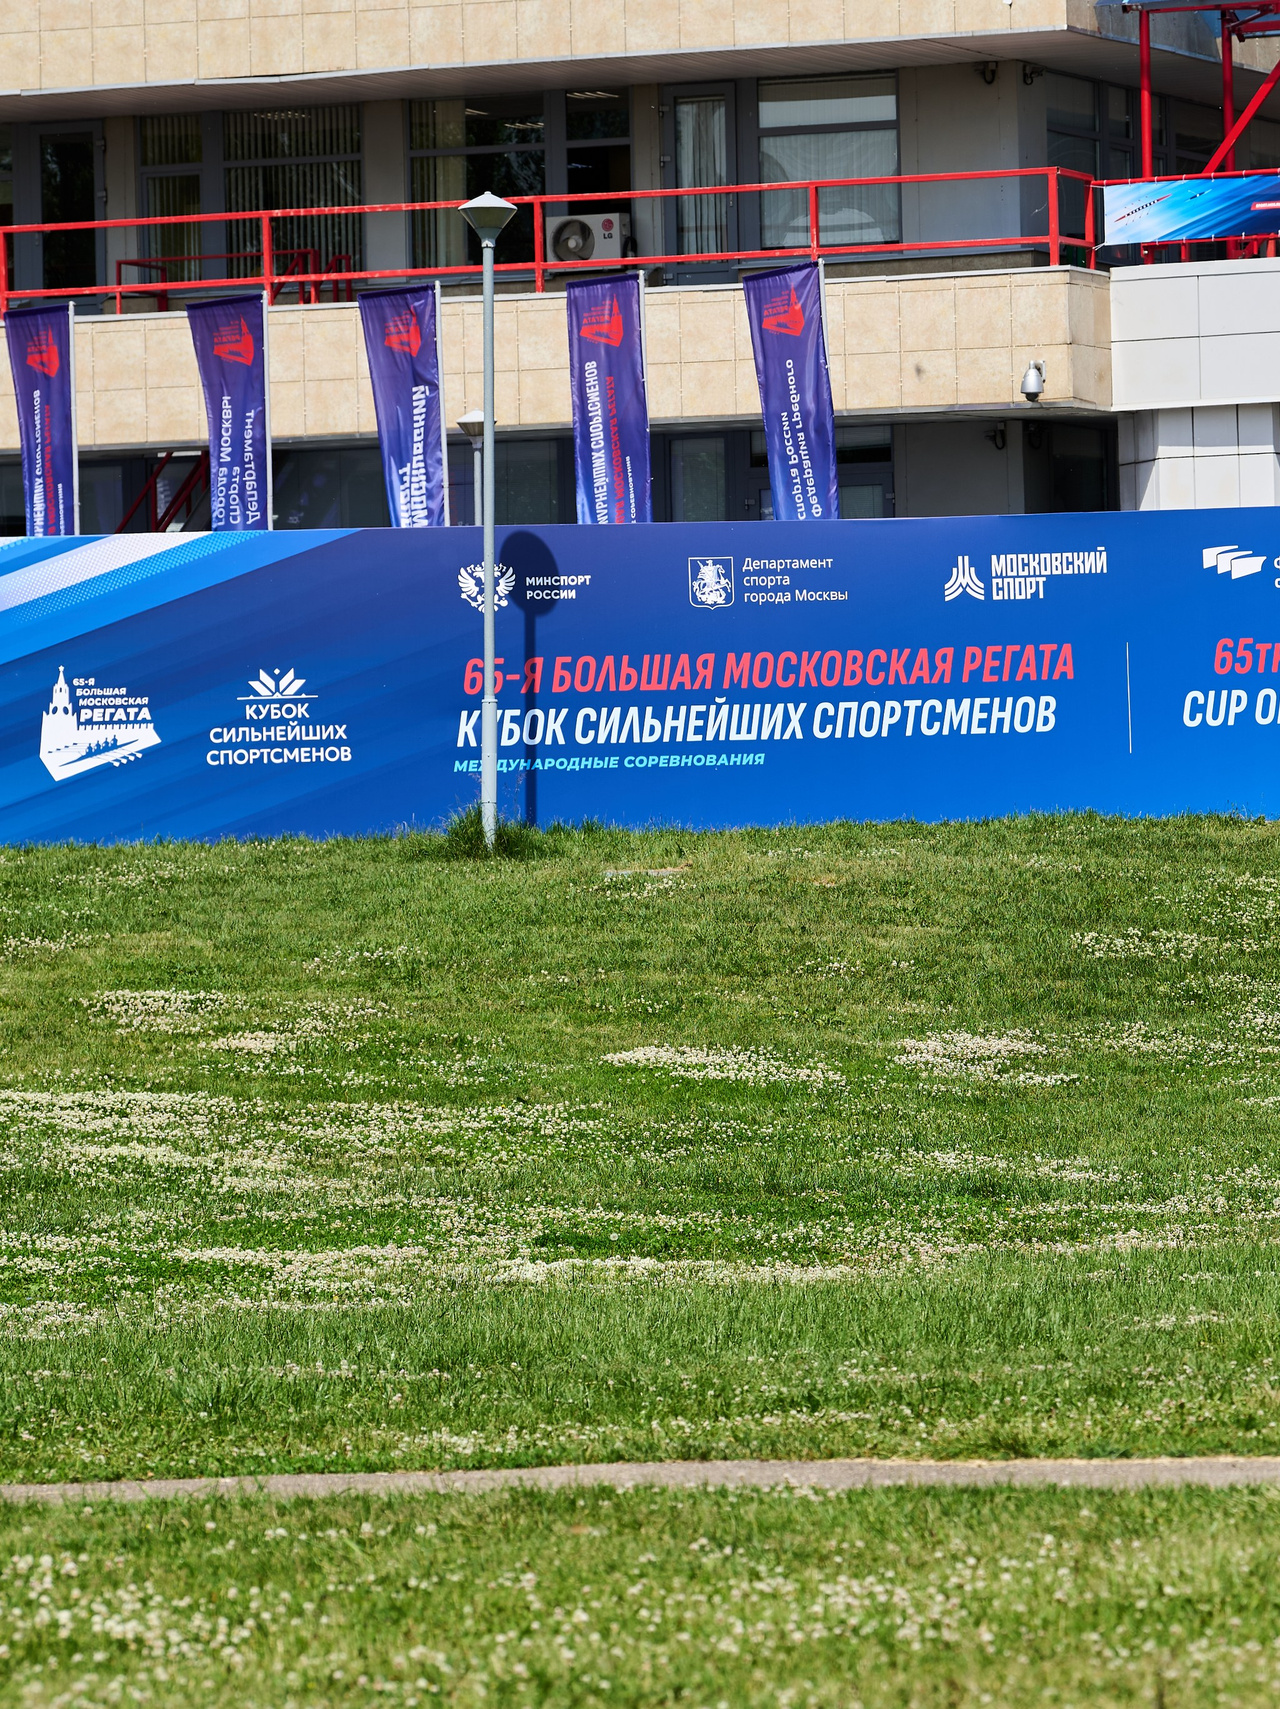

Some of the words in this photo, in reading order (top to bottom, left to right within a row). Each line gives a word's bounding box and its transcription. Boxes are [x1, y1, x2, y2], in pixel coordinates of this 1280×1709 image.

[603, 232, 613, 240] LG
[742, 556, 834, 572] Департамент
[991, 546, 1108, 576] МОСКОВСКИЙ
[526, 574, 592, 586] МИНСПОРТ
[743, 573, 790, 590] спорта
[992, 577, 1046, 600] СПОРТ
[526, 588, 576, 600] РОССИИ
[744, 590, 792, 606] города
[795, 588, 848, 602] Москвы
[551, 653, 716, 693] БОЛЬШАЯ
[722, 647, 954, 690] МОСКОВСКАЯ
[962, 643, 1075, 683] РЕГАТА
[72, 678, 95, 686] 65-Я
[76, 687, 127, 696] БОЛЬШАЯ
[79, 696, 149, 706] МОСКОВСКАЯ
[1183, 690, 1248, 728] CUP
[80, 706, 152, 723] РЕГАТА
[245, 703, 310, 720] КУБОК
[456, 707, 568, 748] КБОК
[574, 696, 807, 744] СИЛЬНЕЙШИХ
[812, 695, 1058, 739] СПОРТСМЕНОВ
[209, 721, 348, 744] СИЛЬНЕЙШИХ
[206, 746, 352, 766] СПОРТСМЕНОВ
[454, 756, 619, 773] МЕДУНАРОДНЫЕ
[624, 752, 766, 769] СОРЕВНОВАНИЯ
